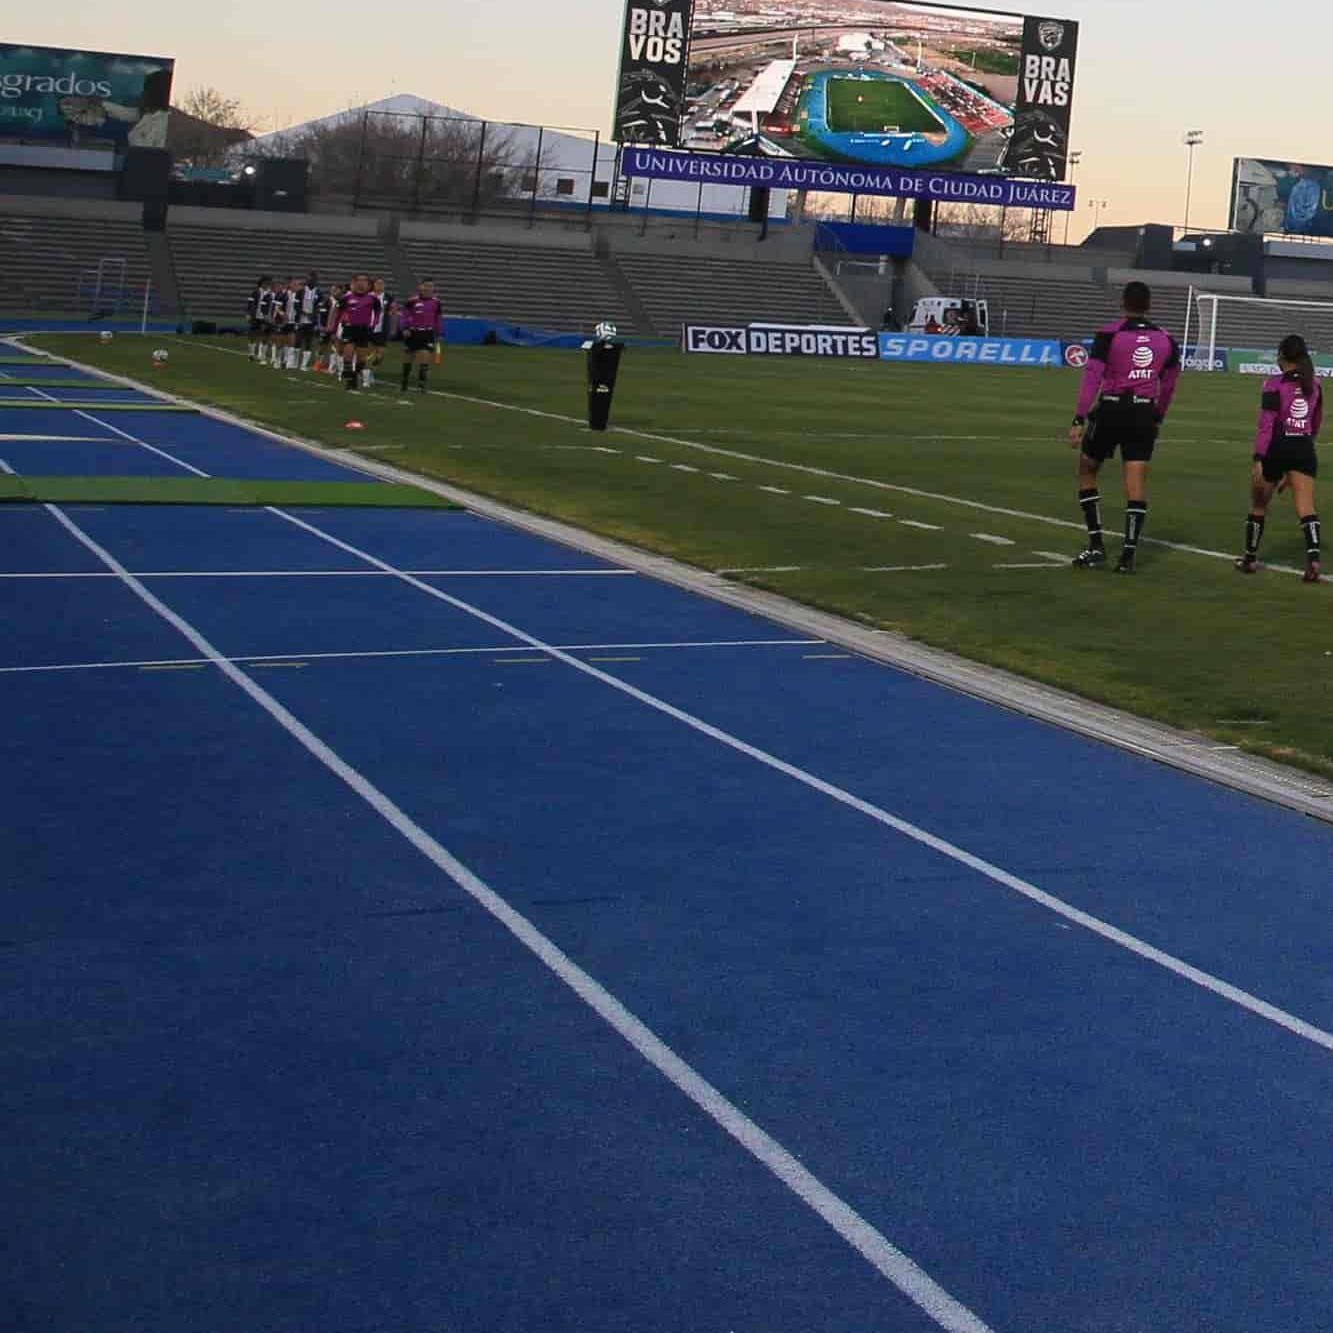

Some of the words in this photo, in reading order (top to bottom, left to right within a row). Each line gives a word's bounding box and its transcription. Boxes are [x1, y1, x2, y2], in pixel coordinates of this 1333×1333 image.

[629, 8, 683, 39] BRA
[629, 34, 682, 64] VOS
[1024, 54, 1071, 83] BRA
[0, 71, 112, 99] grados
[1024, 78, 1069, 106] VAS
[635, 153, 774, 180] UNIVERSIDAD
[778, 166, 893, 189] AUTÓNOMA
[928, 177, 1002, 199] CIUDAD
[1008, 183, 1073, 205] JUÁREZ
[690, 328, 746, 353] FOX
[750, 331, 878, 357] DEPORTES
